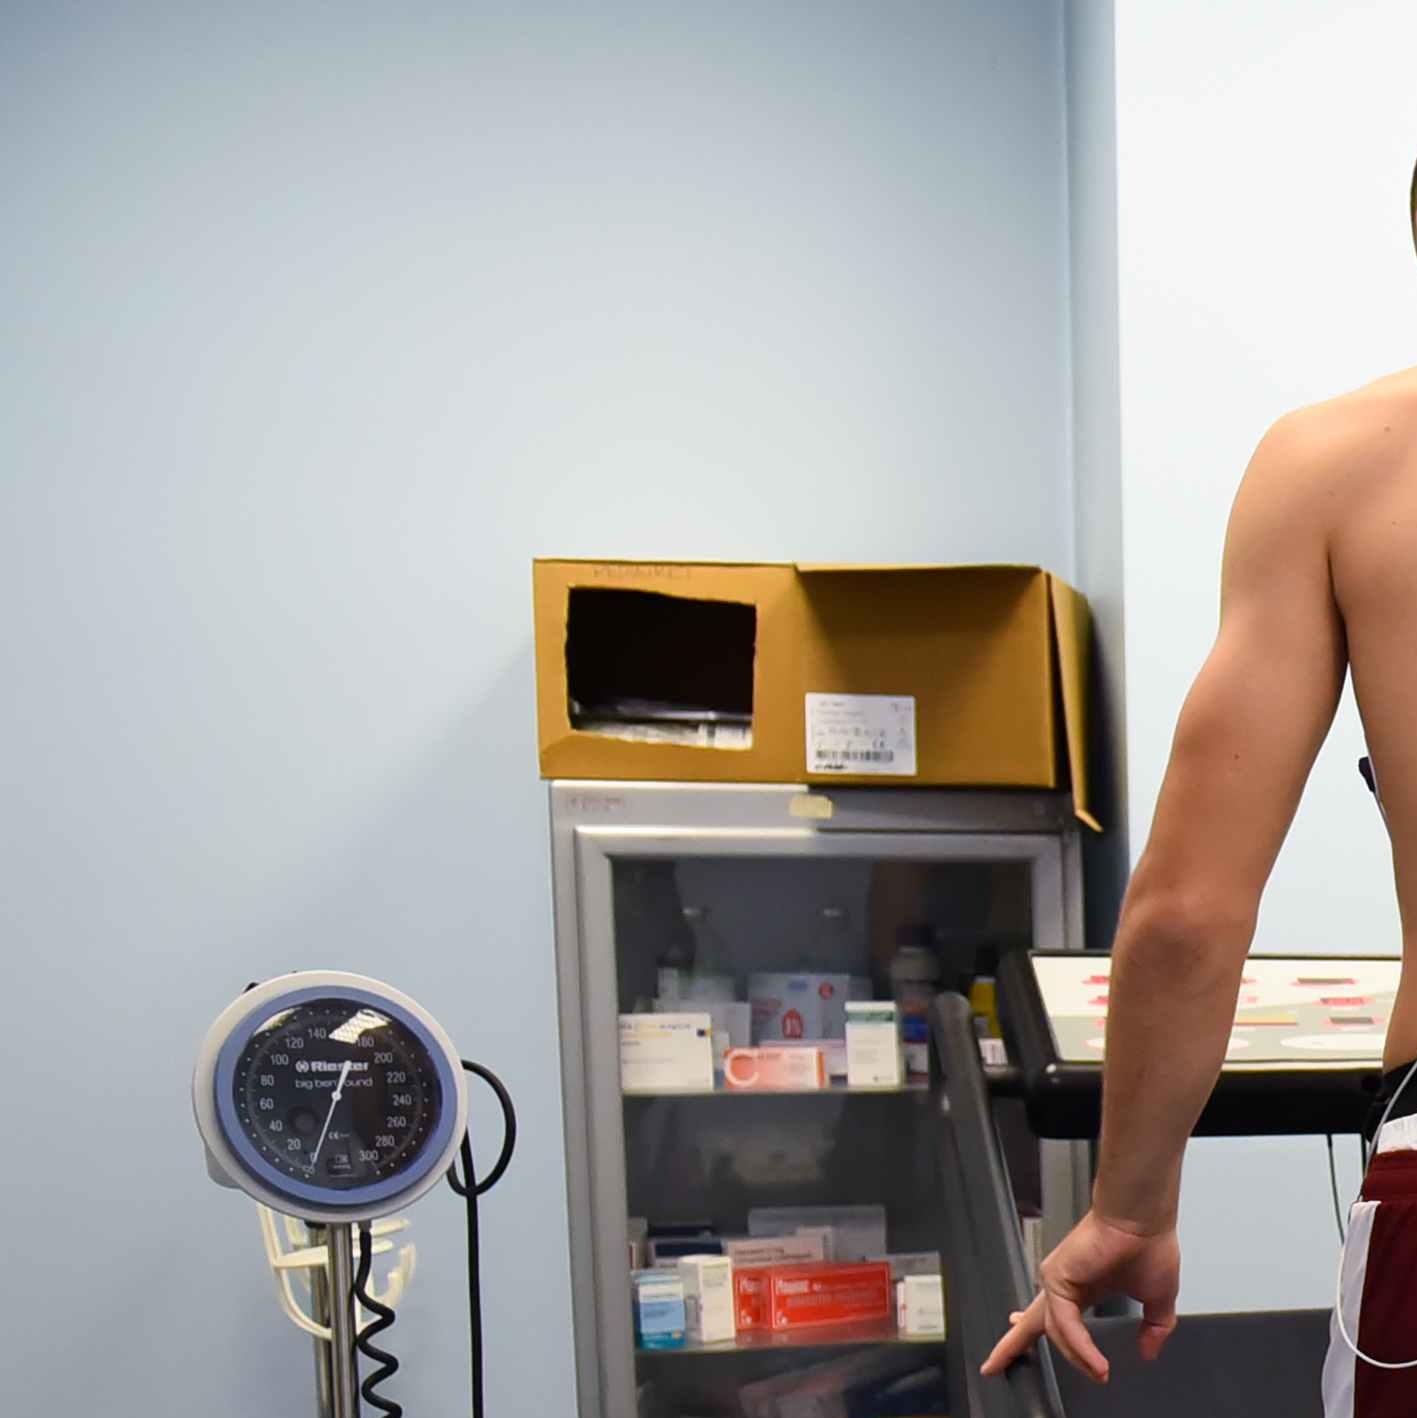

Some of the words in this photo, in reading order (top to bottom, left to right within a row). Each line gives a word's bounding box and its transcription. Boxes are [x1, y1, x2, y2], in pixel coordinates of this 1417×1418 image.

[308, 1028, 326, 1039] 140
[285, 1037, 304, 1049] 120
[357, 1037, 375, 1048] 180
[270, 1054, 289, 1065] 100
[374, 1052, 393, 1063] 200
[260, 1074, 275, 1086] 80
[386, 1071, 406, 1083] 220
[295, 1079, 313, 1090] big
[260, 1098, 274, 1110] 60
[393, 1094, 412, 1106] 240
[269, 1120, 283, 1131] 40
[387, 1116, 406, 1127] 260
[287, 1138, 301, 1150] 20
[375, 1135, 395, 1147] 280
[359, 1150, 378, 1161] 300
